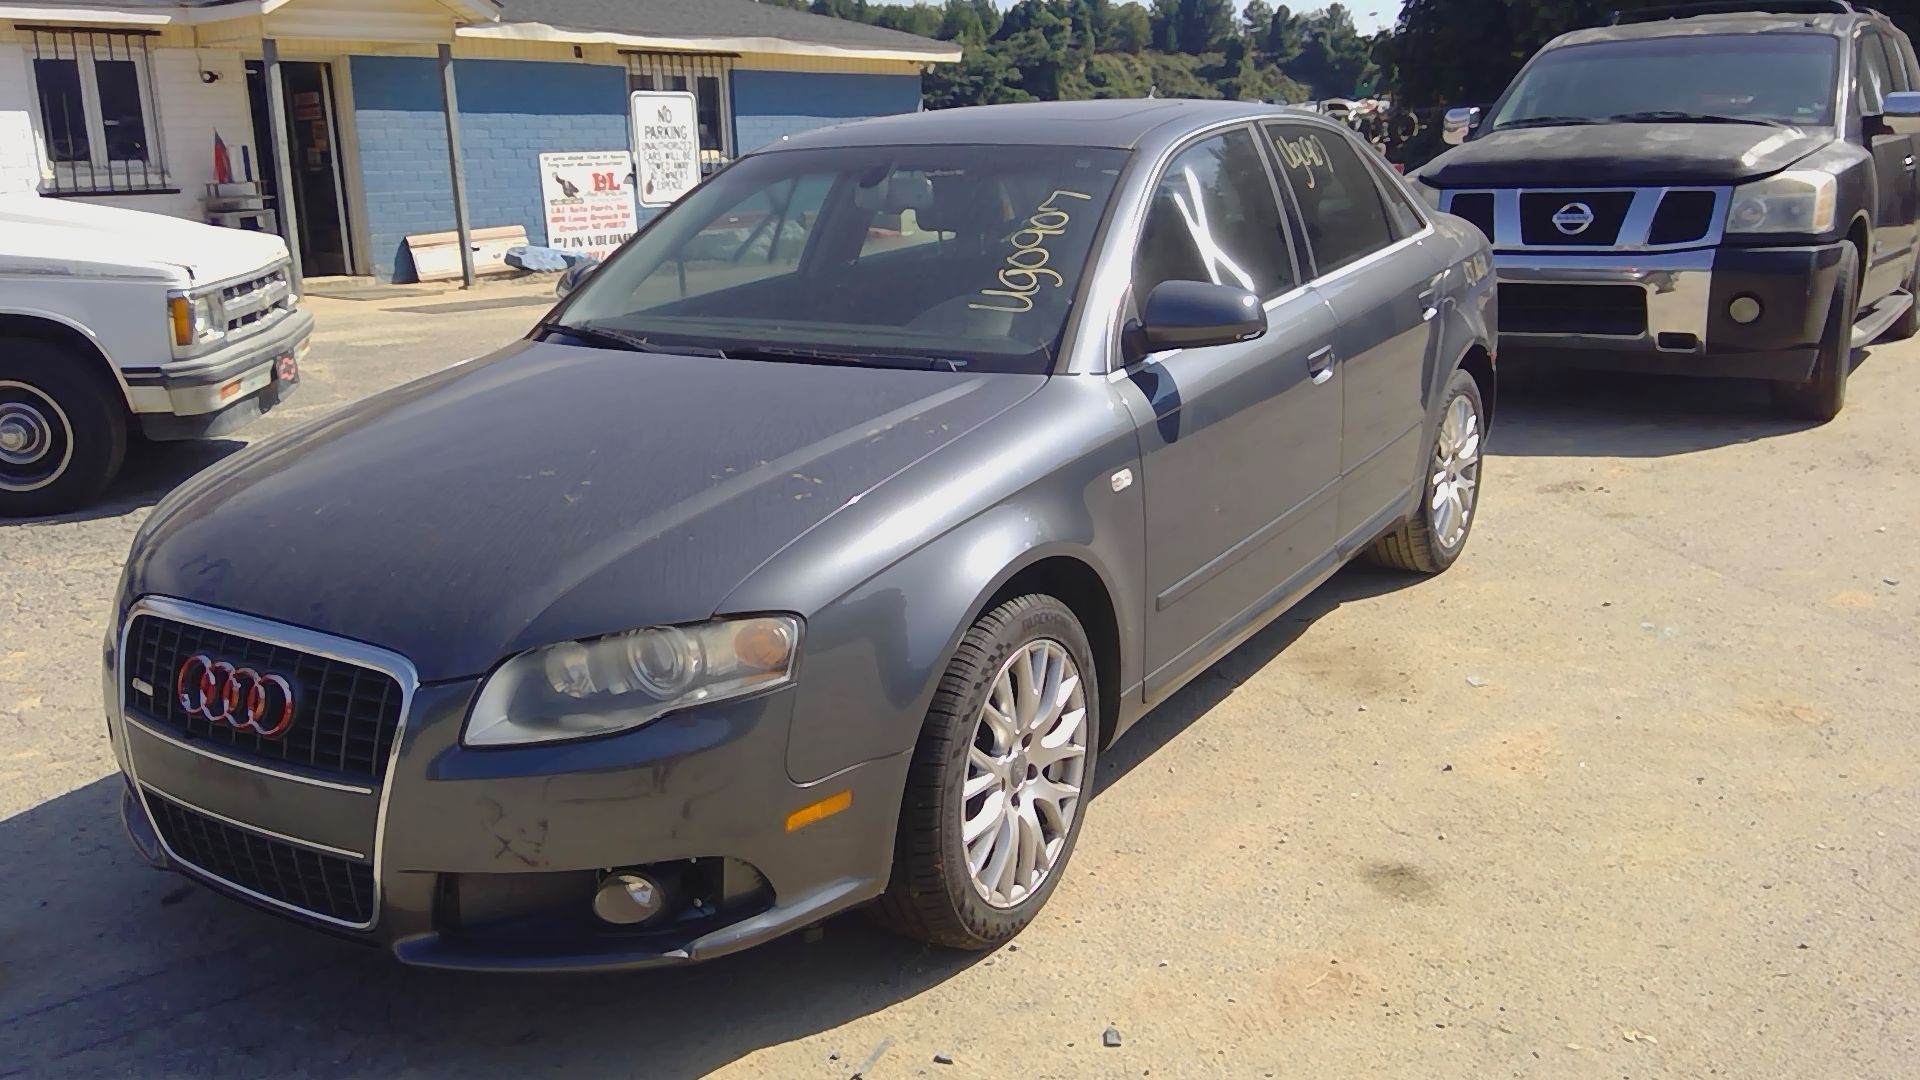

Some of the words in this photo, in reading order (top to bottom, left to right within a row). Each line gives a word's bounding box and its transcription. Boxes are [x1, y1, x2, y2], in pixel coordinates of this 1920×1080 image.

[657, 107, 672, 123] NO
[644, 125, 687, 140] PARKING
[643, 151, 661, 161] CARS
[665, 151, 680, 161] WILL
